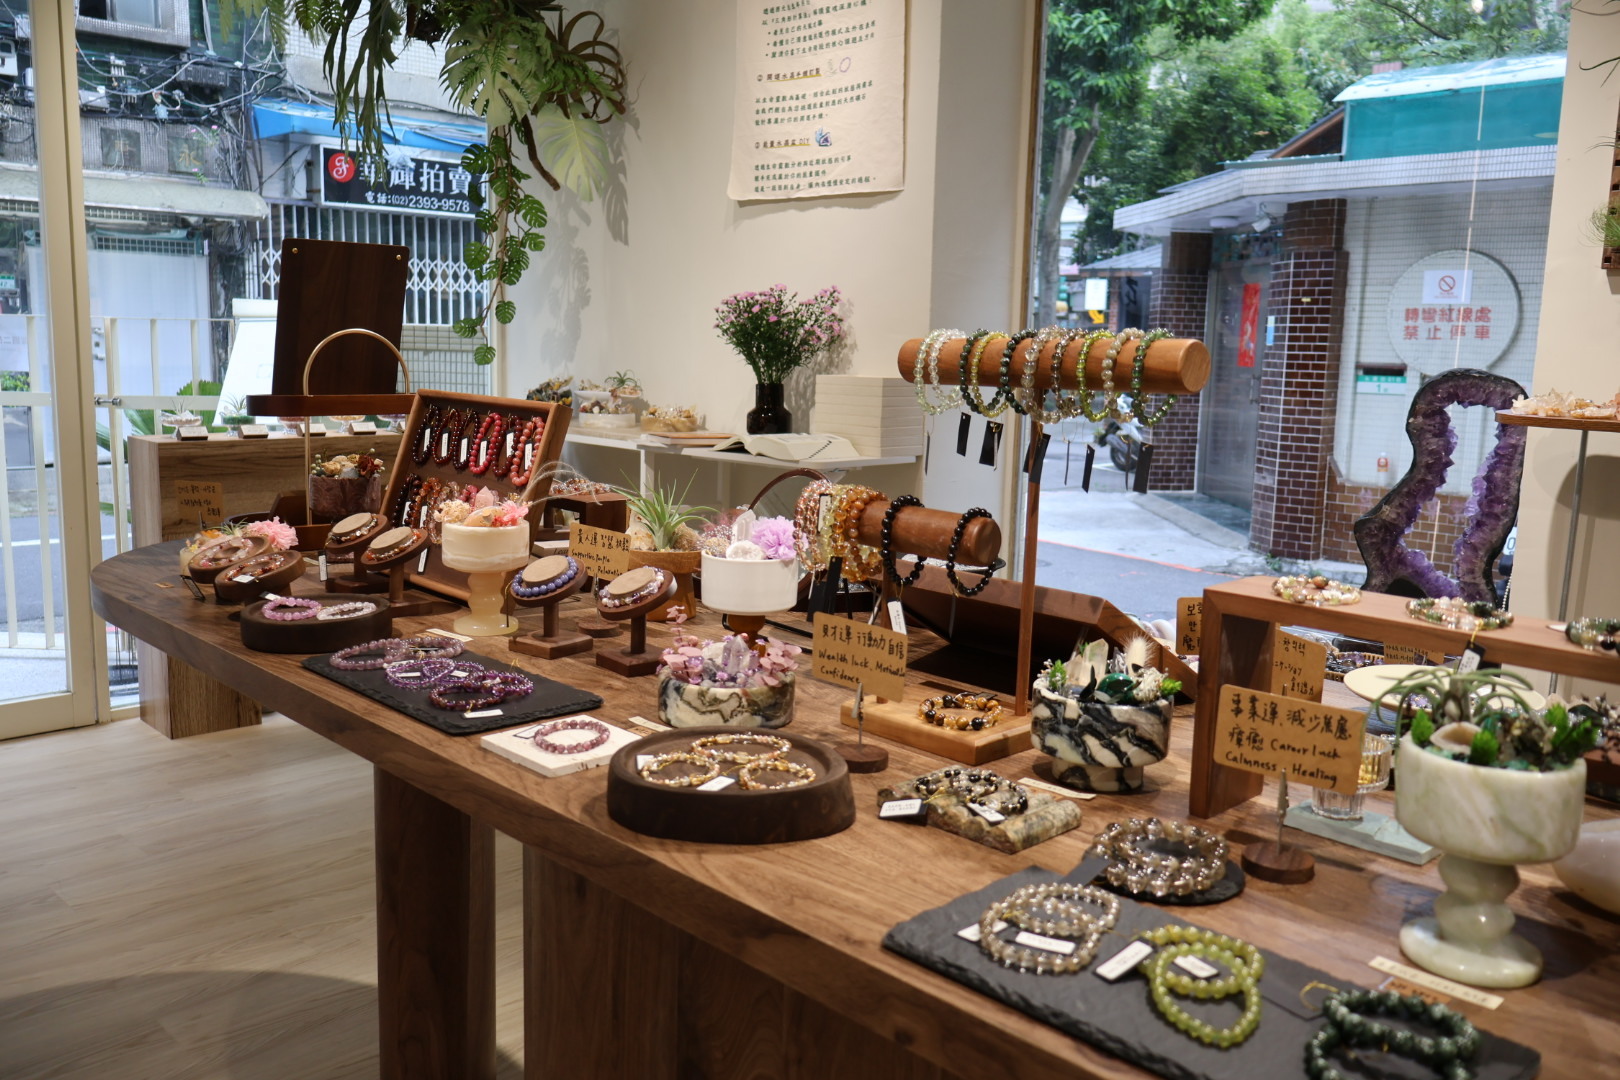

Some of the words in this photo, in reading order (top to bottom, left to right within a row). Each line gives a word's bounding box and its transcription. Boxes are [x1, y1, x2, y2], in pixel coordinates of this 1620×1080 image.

[1404, 306, 1492, 323] 轉彎紅線處
[1403, 325, 1491, 341] 禁止停車
[596, 553, 610, 565] People
[822, 624, 852, 645] 財運
[857, 630, 886, 650] 行動力
[888, 639, 905, 660] 自信
[819, 648, 848, 664] Wealth
[820, 665, 861, 684] Confidence
[1270, 739, 1307, 756] Career
[1312, 744, 1341, 760] luck
[1225, 751, 1277, 772] Calmness
[1292, 764, 1337, 789] Healing
